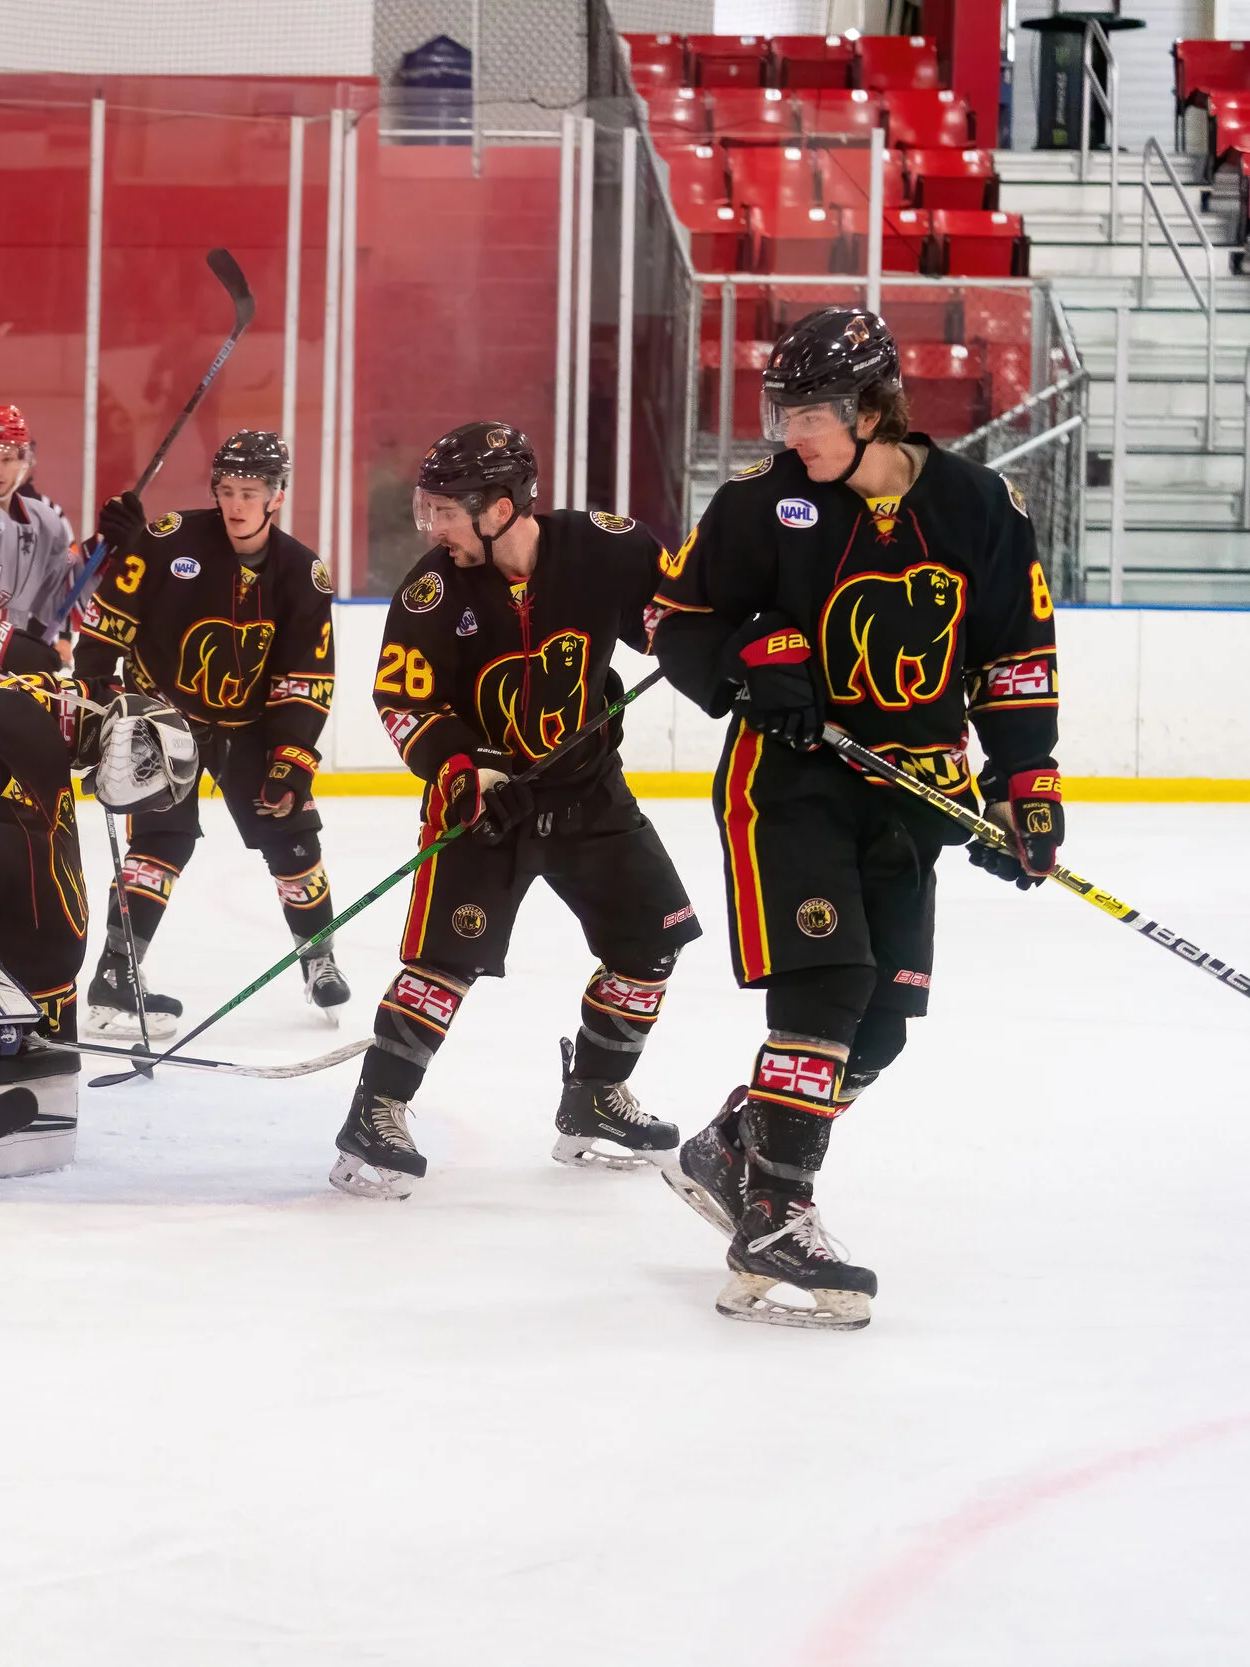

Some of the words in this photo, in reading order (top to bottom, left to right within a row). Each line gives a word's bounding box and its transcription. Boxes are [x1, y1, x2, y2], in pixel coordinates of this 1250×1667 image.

[780, 505, 814, 522] NAHL
[115, 554, 147, 594] 3
[174, 562, 197, 574] NAHL
[1029, 560, 1054, 623] 8
[314, 621, 331, 659] 3
[374, 642, 434, 700] 28
[477, 747, 503, 756] BAUER
[800, 900, 832, 914] MARYLAND
